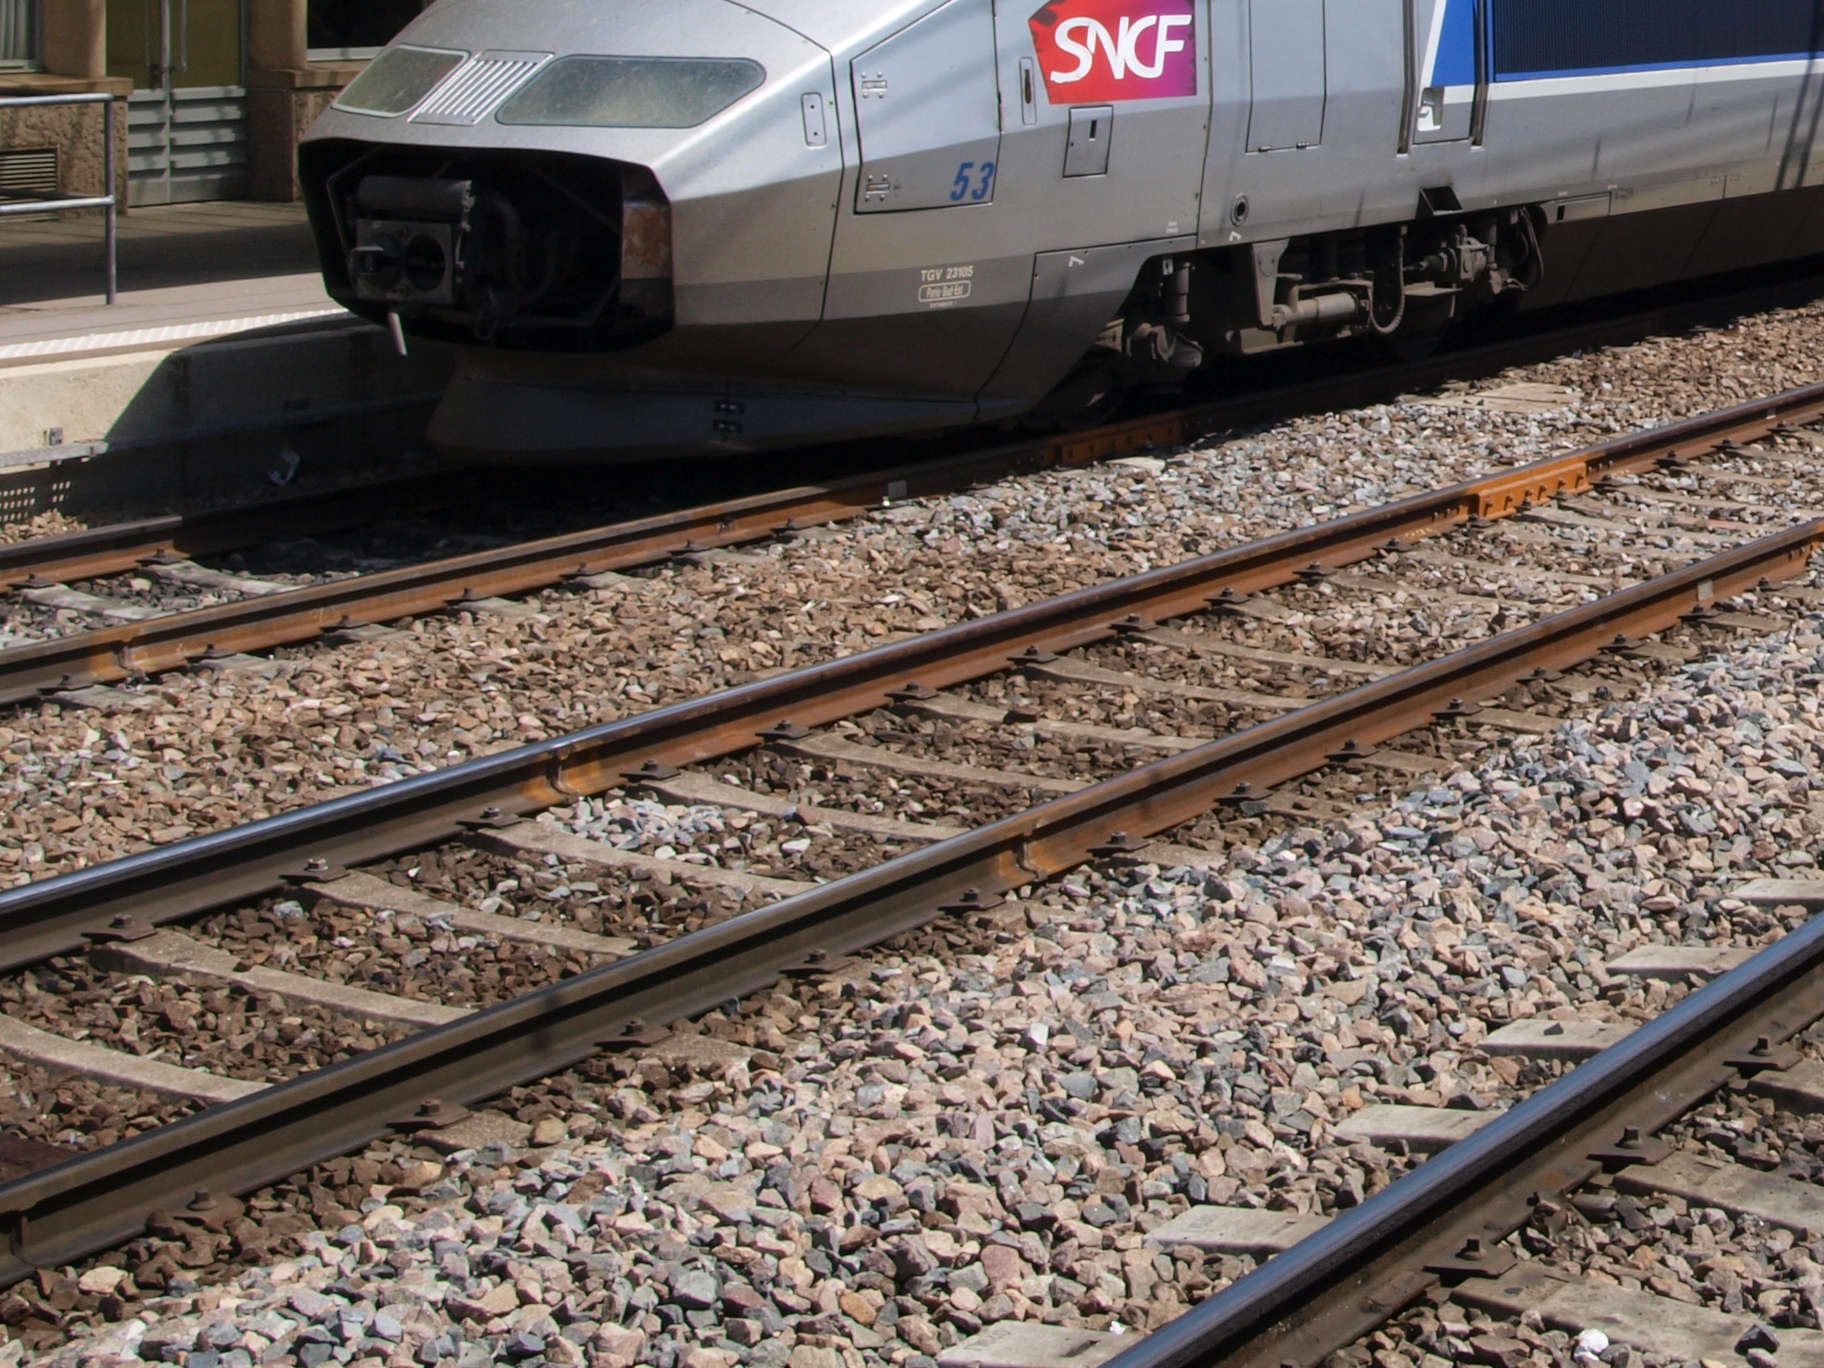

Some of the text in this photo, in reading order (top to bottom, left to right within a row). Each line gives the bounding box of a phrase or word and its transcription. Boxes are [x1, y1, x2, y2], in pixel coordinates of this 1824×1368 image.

[1050, 14, 1193, 83] SNCF
[950, 161, 995, 202] 53
[920, 264, 974, 282] TGV 23105
